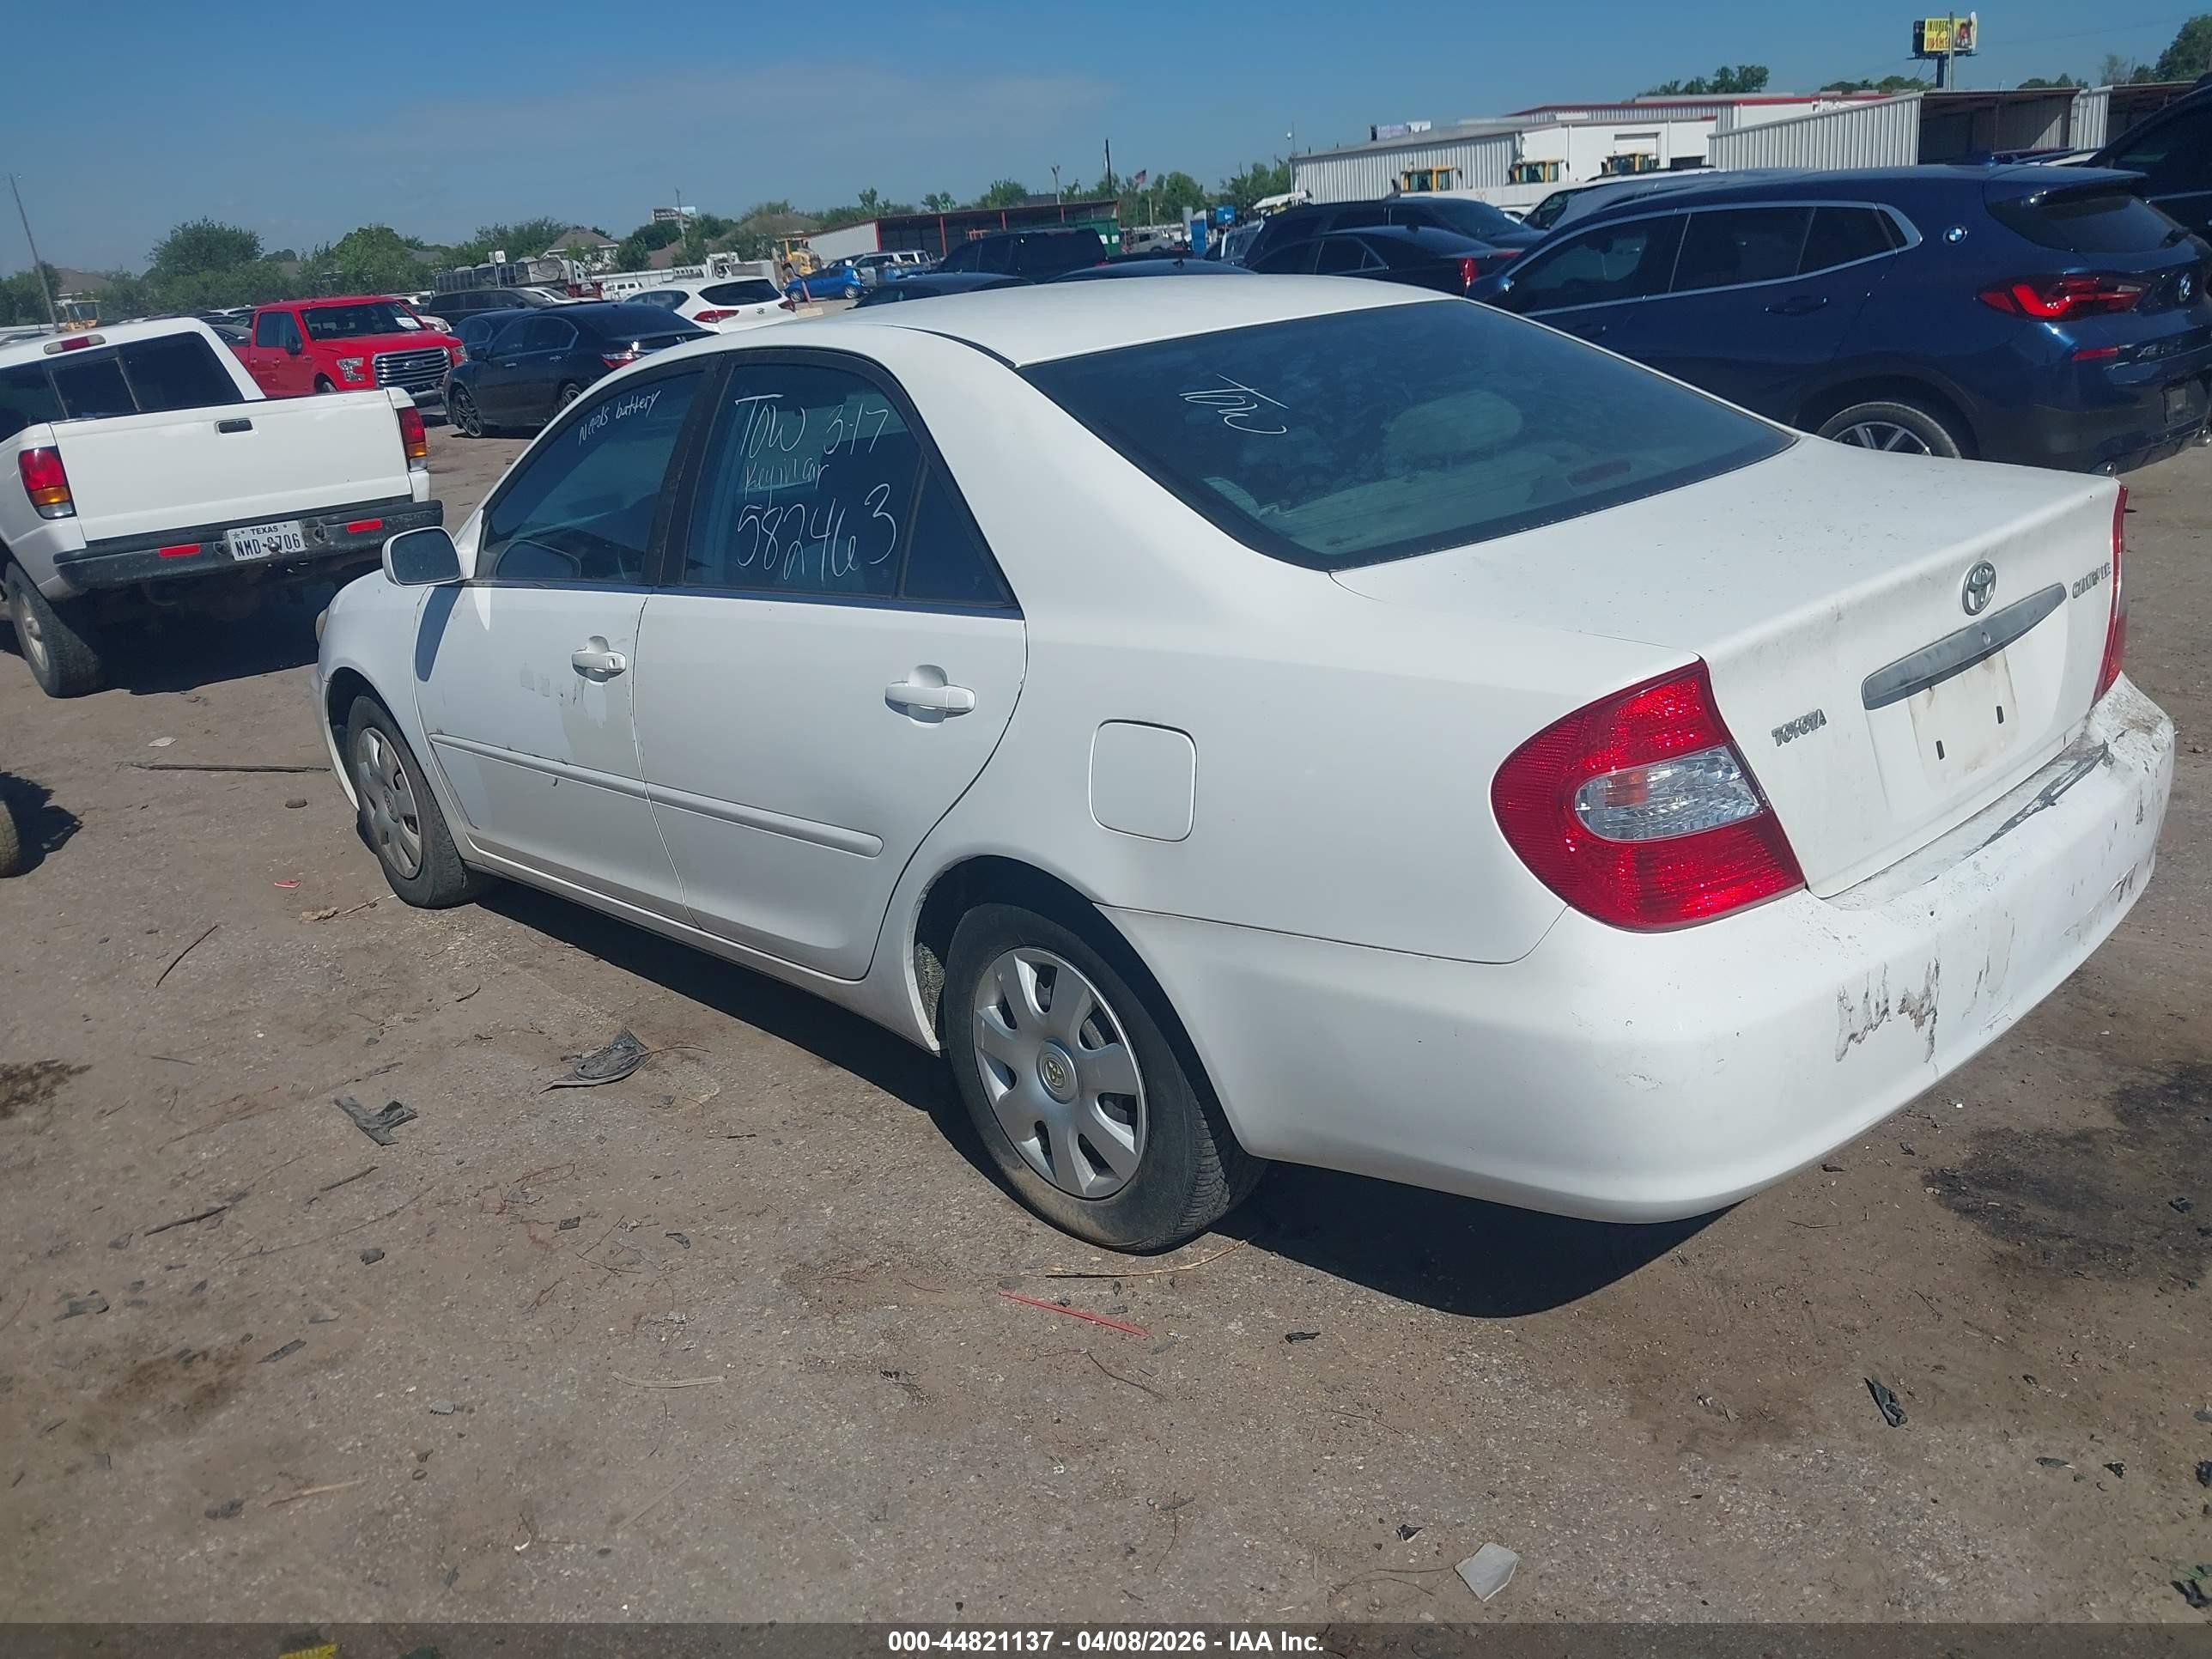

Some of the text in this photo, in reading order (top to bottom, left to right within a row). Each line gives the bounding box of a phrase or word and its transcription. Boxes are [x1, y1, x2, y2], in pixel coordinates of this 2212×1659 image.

[251, 526, 278, 535] TEXAS
[737, 483, 897, 582] 582463
[1771, 708, 1827, 747] TOYOTA
